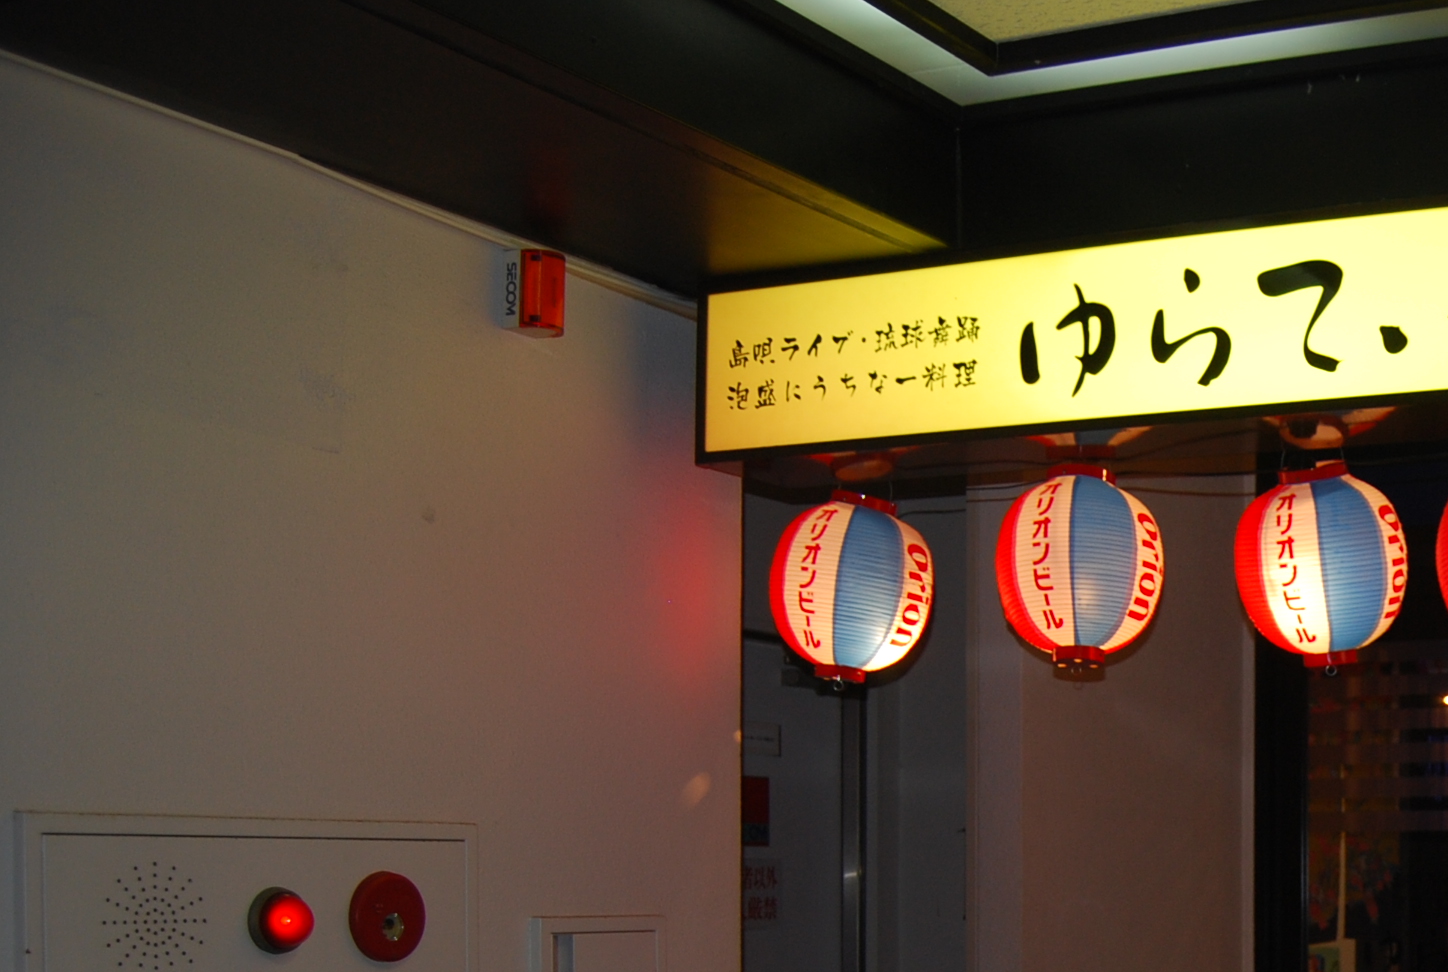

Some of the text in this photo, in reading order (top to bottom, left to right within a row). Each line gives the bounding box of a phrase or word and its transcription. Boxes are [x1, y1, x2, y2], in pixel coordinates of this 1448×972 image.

[505, 262, 517, 316] SECOM
[728, 315, 981, 370] 島唄ライブ・琉球舞踊
[726, 359, 979, 410] 泡盛にうちなー料理
[798, 508, 838, 650] オリオンビール
[890, 543, 929, 648] Orion
[1032, 482, 1065, 630] オリオンビール
[1127, 512, 1164, 622] Orion
[1275, 493, 1317, 644] オリオンビール
